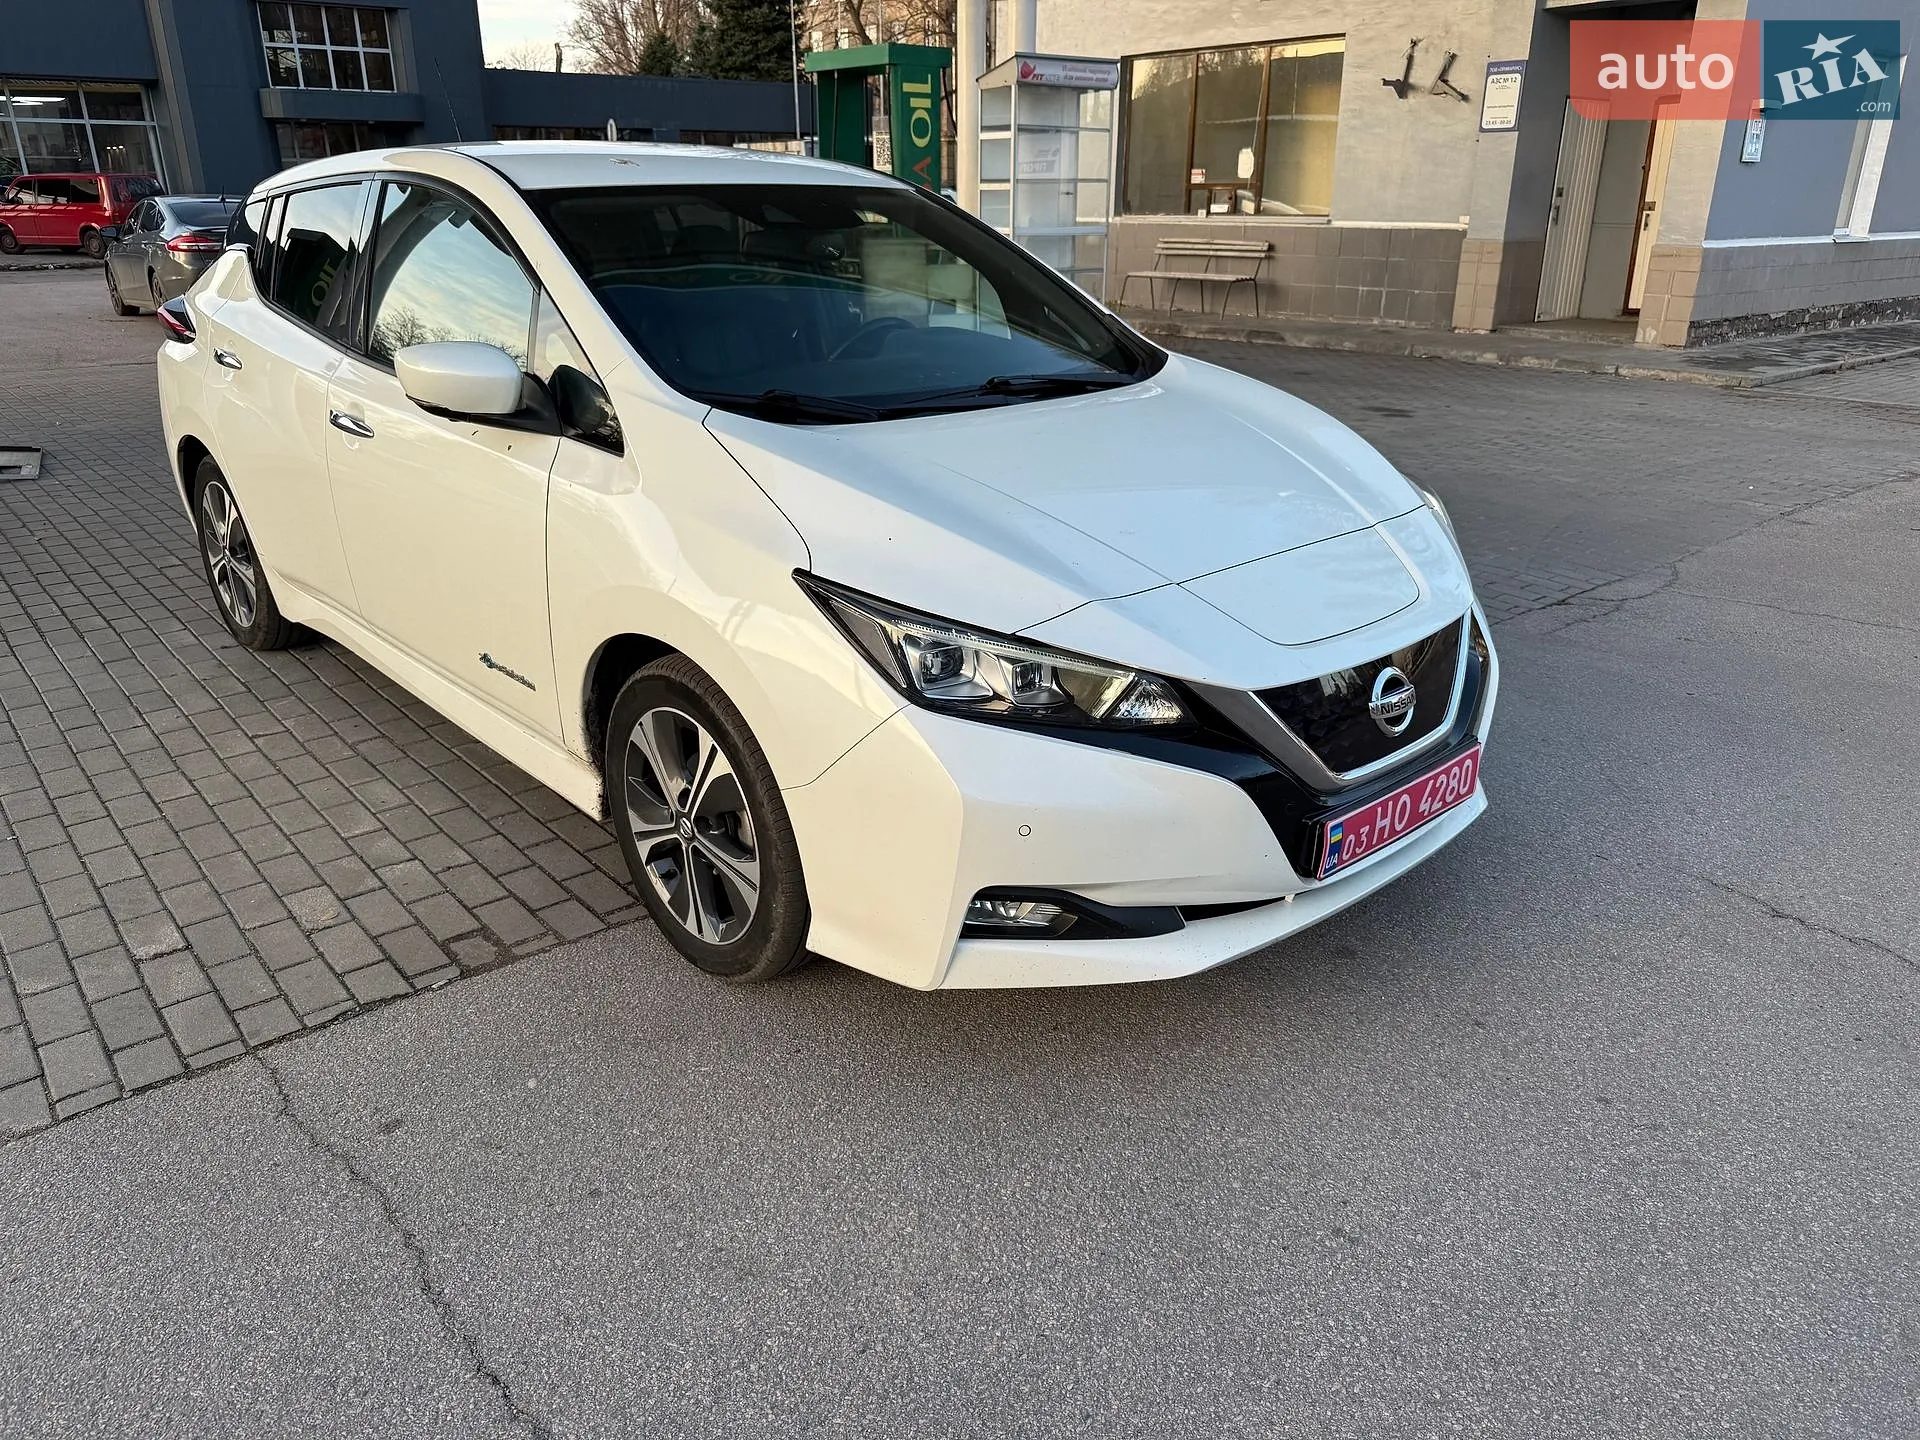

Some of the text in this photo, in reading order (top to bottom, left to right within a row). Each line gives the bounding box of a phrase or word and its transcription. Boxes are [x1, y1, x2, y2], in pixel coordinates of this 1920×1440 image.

[1490, 77, 1503, 85] АЗС
[902, 73, 932, 148] OIL
[1380, 692, 1415, 715] NISSAN
[1342, 758, 1473, 861] 03 HO 4280
[1325, 853, 1338, 869] UA
